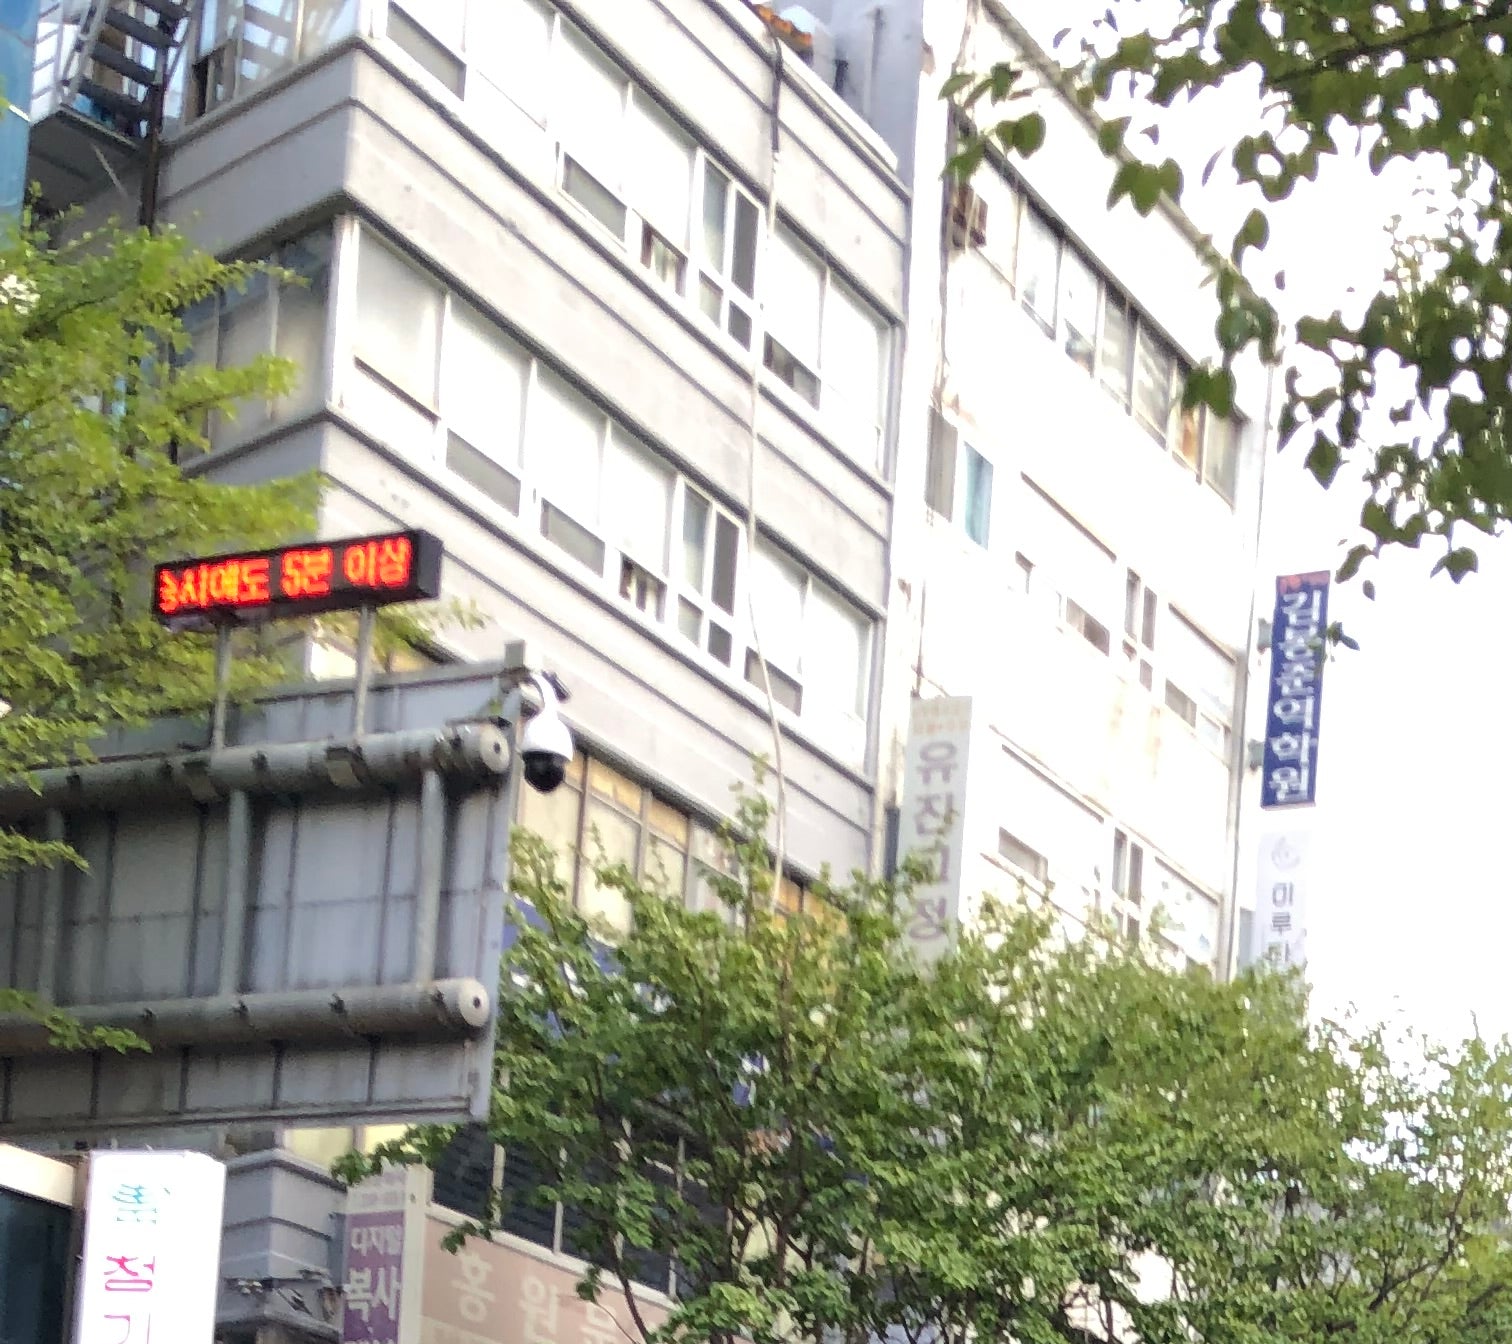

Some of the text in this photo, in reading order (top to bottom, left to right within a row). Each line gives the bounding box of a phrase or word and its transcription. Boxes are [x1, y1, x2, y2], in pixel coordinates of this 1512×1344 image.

[281, 547, 334, 598] 5분
[344, 537, 412, 588] 이상
[348, 1265, 400, 1322] 복사
